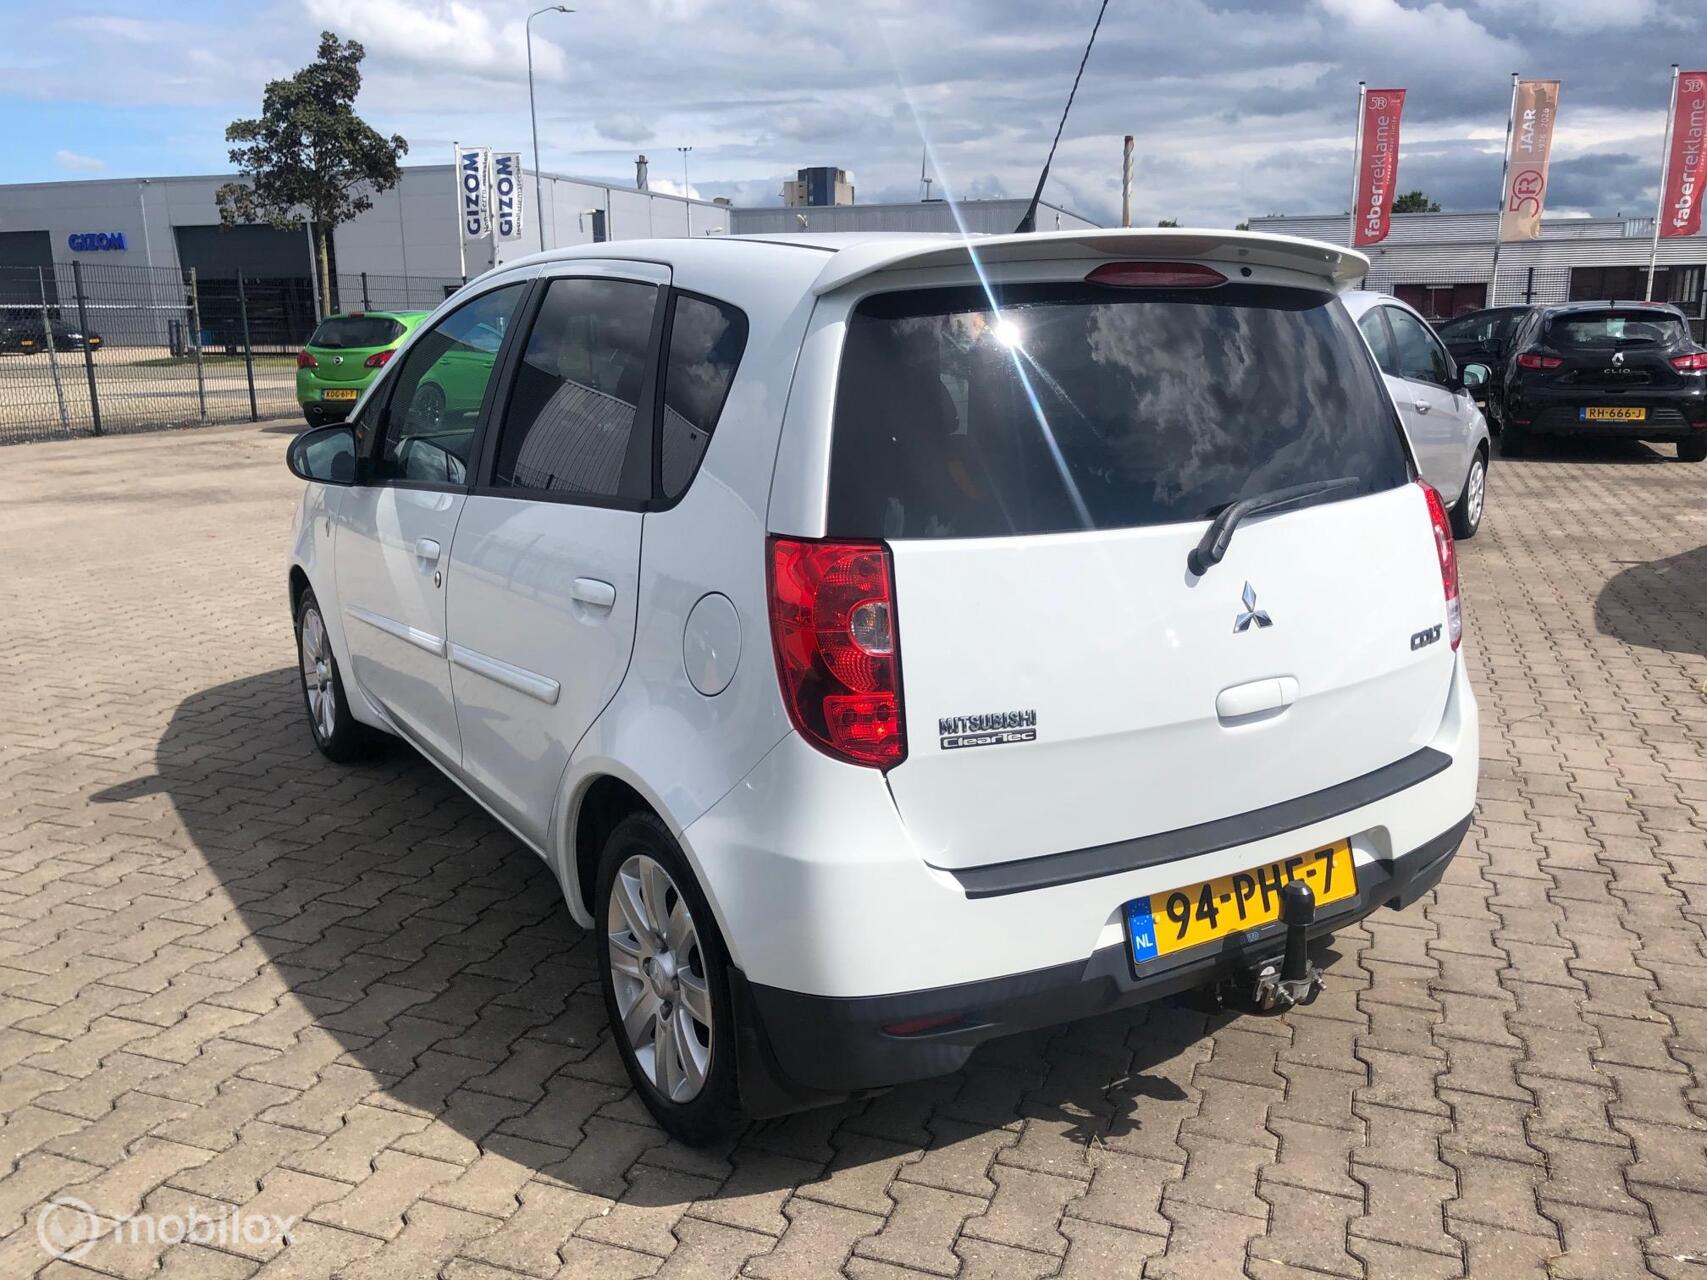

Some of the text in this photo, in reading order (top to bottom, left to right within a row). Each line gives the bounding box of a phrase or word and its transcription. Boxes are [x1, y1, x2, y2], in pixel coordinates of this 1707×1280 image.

[1520, 109, 1537, 153] JAAR
[1365, 116, 1390, 237] faberreklame
[462, 152, 480, 235] GIZOM
[496, 156, 513, 236] GIZOM
[68, 232, 126, 252] GIZOM
[1589, 408, 1641, 418] RH-666-J
[1410, 623, 1442, 651] COLT
[938, 709, 1037, 735] MITSUBISHI
[942, 732, 1035, 748] ClearTec
[1135, 932, 1153, 950] NL
